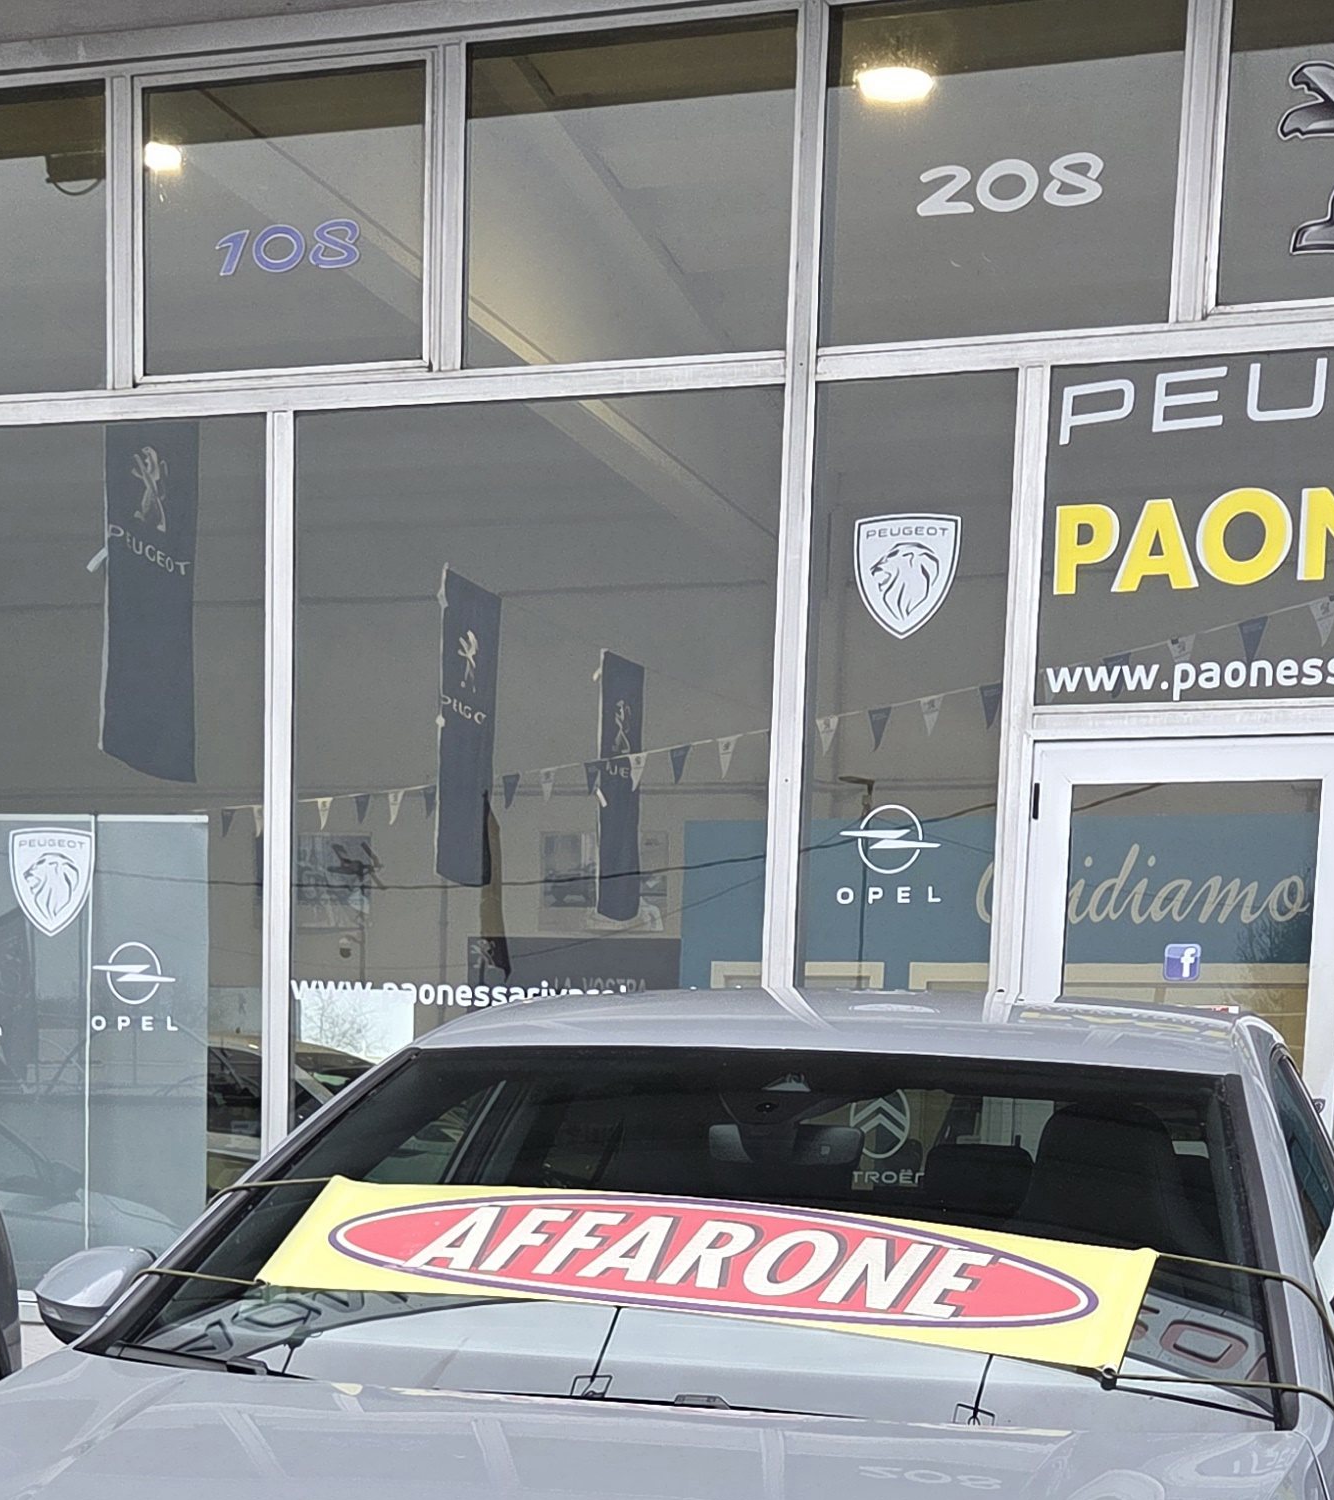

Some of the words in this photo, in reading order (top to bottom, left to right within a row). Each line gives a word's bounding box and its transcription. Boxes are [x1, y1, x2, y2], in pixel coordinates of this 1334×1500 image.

[916, 151, 1104, 217] 208
[214, 217, 361, 277] 108
[108, 524, 191, 576] PEUGEOT
[866, 526, 949, 540] PEUGEOT
[18, 838, 87, 849] PEUGEOT
[835, 886, 942, 905] OPEL
[976, 843, 1310, 926] idiamo
[90, 1015, 179, 1031] OPEL
[418, 1204, 999, 1320] AFFARONE
